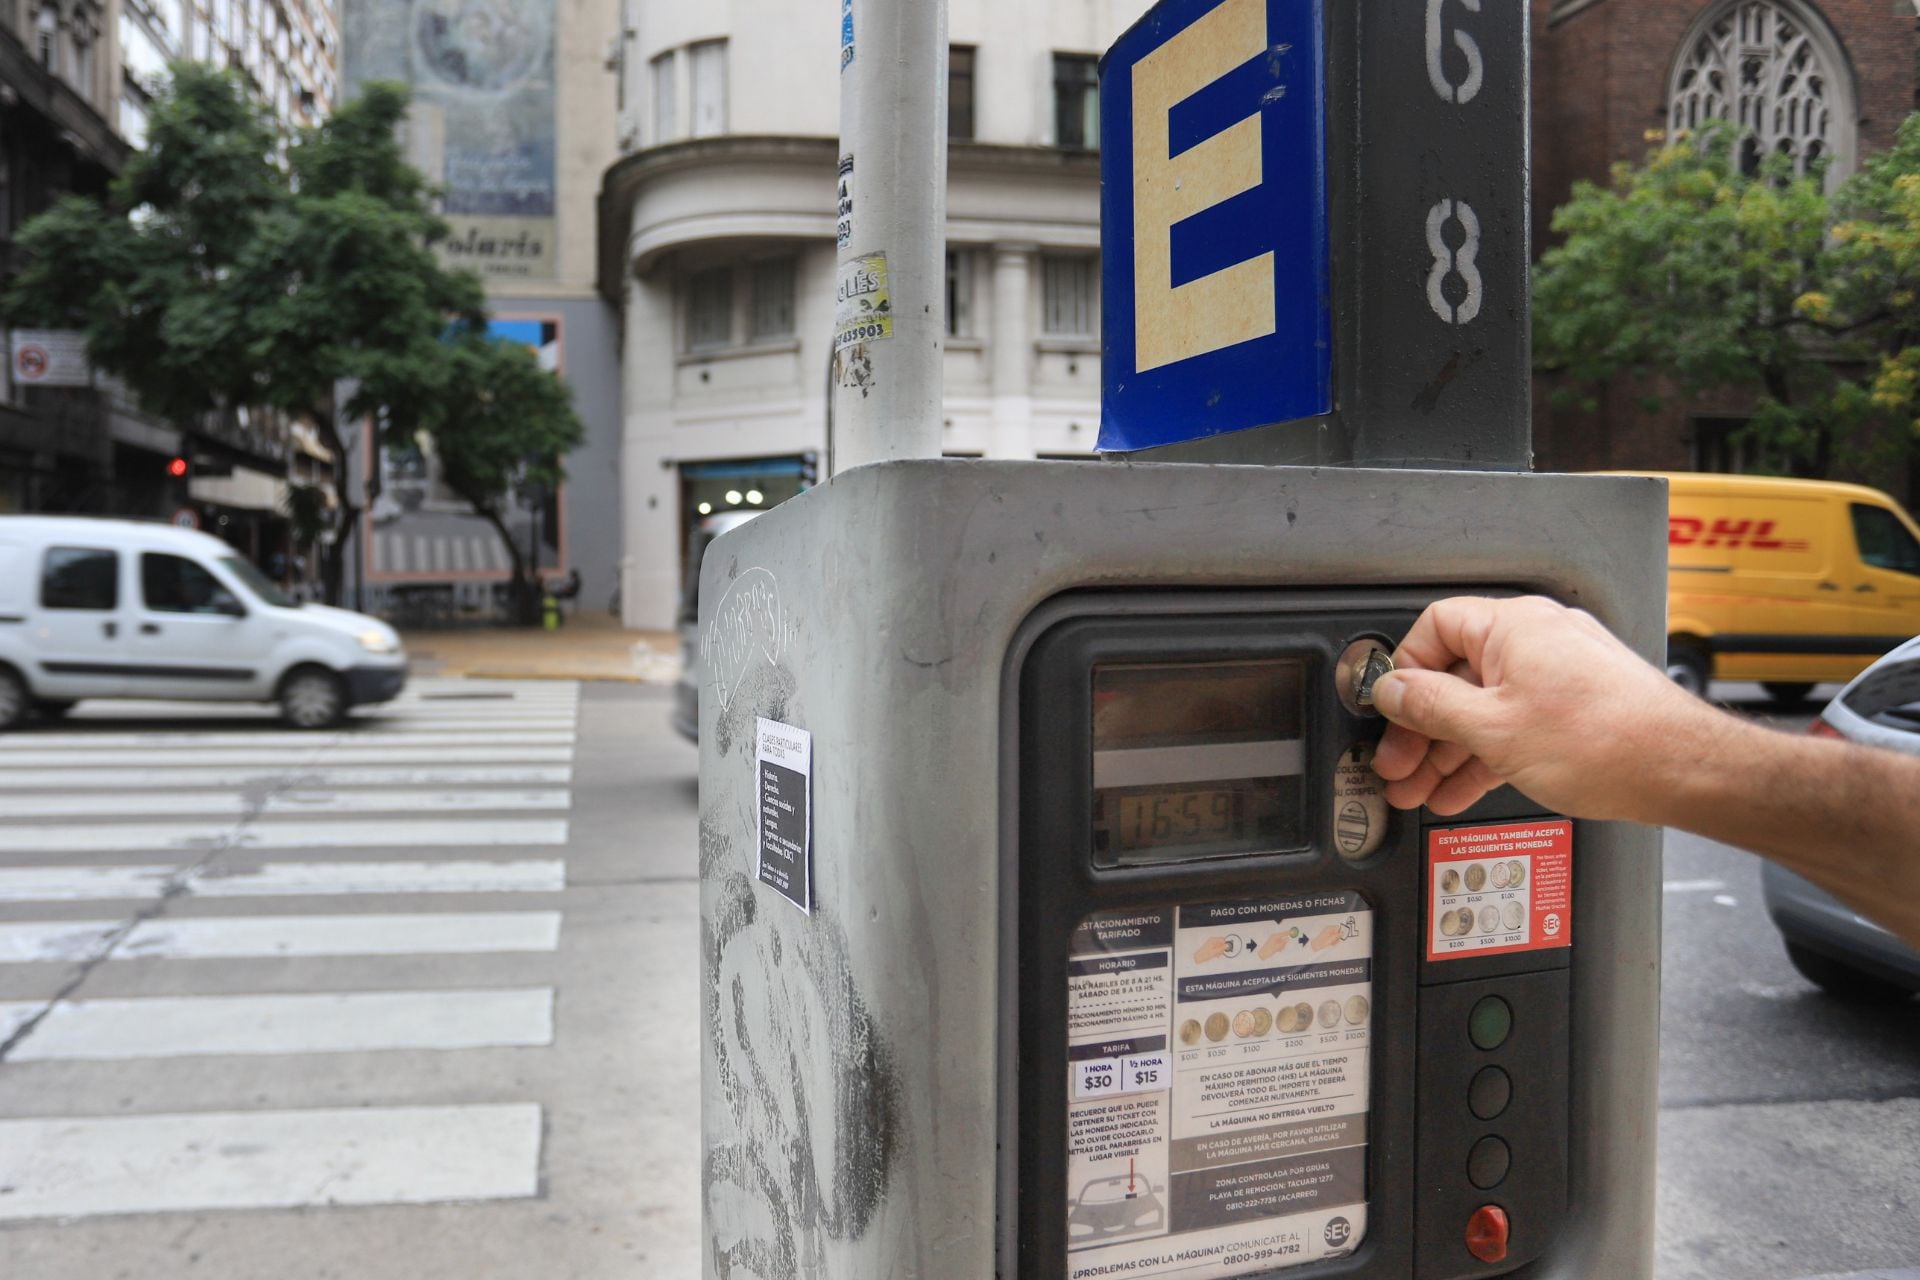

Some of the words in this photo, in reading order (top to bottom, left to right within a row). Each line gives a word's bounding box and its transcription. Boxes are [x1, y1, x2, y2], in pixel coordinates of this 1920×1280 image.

[1132, 0, 1276, 373] E
[1669, 516, 1782, 549] DHL
[1439, 837, 1459, 845] ESTA
[1460, 833, 1498, 844] MÁQUINA
[1500, 829, 1534, 840] TAMBIÉN
[1535, 827, 1564, 838] ACEPTA
[1451, 846, 1466, 855] LAS
[1468, 842, 1514, 854] SIGUIENTES
[1515, 839, 1553, 850] MONEDAS
[1210, 907, 1235, 918] PAGO
[1237, 905, 1257, 915] CON
[1259, 900, 1303, 913] MONEDAS
[1305, 899, 1312, 908] O
[1314, 896, 1345, 907] FICHAS
[1097, 928, 1141, 940] TARIFADO
[1099, 959, 1136, 970] HORARIO
[1185, 983, 1204, 993] ESTA
[1206, 979, 1241, 991] MÁQUINA
[1242, 976, 1271, 988] ACEPTA
[1272, 975, 1286, 984] LAS
[1287, 970, 1328, 982] SIGUIENTES
[1329, 966, 1364, 976] MONEDAS
[1069, 1008, 1122, 1021] STACIONAMIENTO
[1069, 1018, 1122, 1029] STACIONAMIENTO
[1102, 1044, 1131, 1054] TARIFA
[1089, 1064, 1113, 1074] HORA
[1140, 1059, 1163, 1068] HORA
[1200, 1075, 1210, 1083] EN
[1212, 1072, 1233, 1081] CASO
[1246, 1066, 1277, 1076] ABONAR
[1279, 1062, 1294, 1071] MÁS
[1295, 1061, 1310, 1070] QUE
[1312, 1060, 1321, 1068] EL
[1322, 1056, 1348, 1066] TIEMPO
[1085, 1075, 1112, 1091] $30
[1135, 1070, 1158, 1085] $15
[1205, 1080, 1236, 1091] MÁXIMO
[1237, 1075, 1276, 1087] PERMITIDO
[1298, 1071, 1308, 1079] LA
[1309, 1066, 1343, 1077] MÁQUINA
[1201, 1089, 1245, 1101] DEVOLVERÁ
[1246, 1086, 1267, 1095] TODO
[1279, 1080, 1311, 1090] IMPORTE
[1318, 1075, 1346, 1085] DEBERÁ
[1070, 1106, 1107, 1118] RECUERDE
[1108, 1105, 1122, 1113] QUE
[1136, 1100, 1159, 1110] PUEDE
[1228, 1095, 1270, 1107] COMENZAR
[1072, 1116, 1105, 1127] OBTENER
[1116, 1112, 1140, 1121] TICKET
[1141, 1109, 1156, 1118] CON
[1210, 1120, 1220, 1128] LA
[1222, 1114, 1257, 1126] MÁQUINA
[1259, 1112, 1270, 1120] NO
[1271, 1108, 1306, 1119] ENTREGA
[1307, 1104, 1335, 1115] VUELTO
[1070, 1129, 1084, 1137] LAS
[1085, 1124, 1119, 1134] MONEDAS
[1086, 1135, 1111, 1144] OLVIDE
[1112, 1128, 1154, 1140] COLOCARLO
[1197, 1143, 1208, 1151] EN
[1208, 1140, 1230, 1149] CASO
[1231, 1138, 1242, 1146] DE
[1273, 1130, 1289, 1139] POR
[1289, 1126, 1314, 1137] FAVOR
[1315, 1122, 1347, 1133] UTILIZAR
[1109, 1137, 1151, 1150] PARABRISAS
[1218, 1146, 1253, 1157] MÁQUINA
[1254, 1142, 1270, 1152] MÁS
[1308, 1132, 1340, 1143] GRACIAS
[1089, 1152, 1112, 1162] LUGAR
[1114, 1148, 1139, 1157] VISIBLE
[1216, 1177, 1237, 1187] ZONA
[1238, 1170, 1288, 1183] CONTROLADA
[1289, 1167, 1304, 1175] POR
[1209, 1191, 1232, 1200] PLAYA
[1234, 1189, 1244, 1197] DE
[1319, 1174, 1334, 1182] 1277
[1073, 1261, 1137, 1279] ¿PROBLEMAS
[1138, 1256, 1159, 1268] CON
[1161, 1254, 1174, 1264] LA
[1176, 1245, 1225, 1261] MÁQUINA?
[1288, 1231, 1300, 1241] AL
[1224, 1244, 1300, 1265] 0800-999-4782
